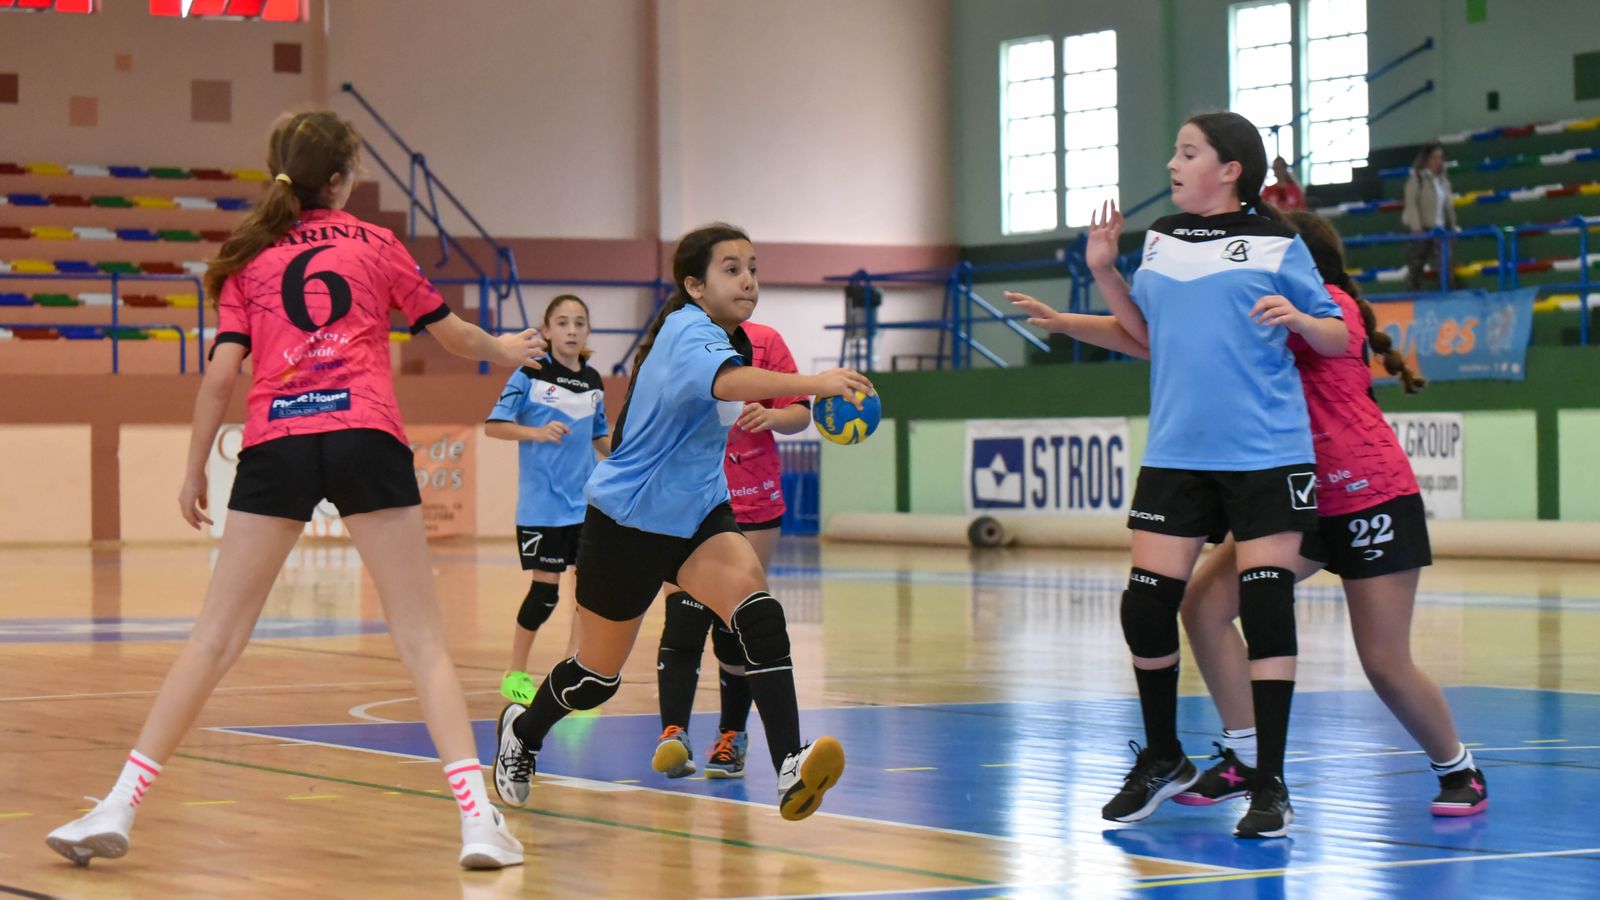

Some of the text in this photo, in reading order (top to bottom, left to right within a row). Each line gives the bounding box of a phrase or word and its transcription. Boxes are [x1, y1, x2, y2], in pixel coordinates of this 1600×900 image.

[273, 226, 369, 248] ARINA
[1172, 228, 1227, 237] GIVOVA
[281, 245, 352, 333] 6
[429, 433, 465, 462] de
[1405, 421, 1460, 457] GROUP
[1032, 435, 1124, 509] STROG
[1348, 513, 1395, 548] 22
